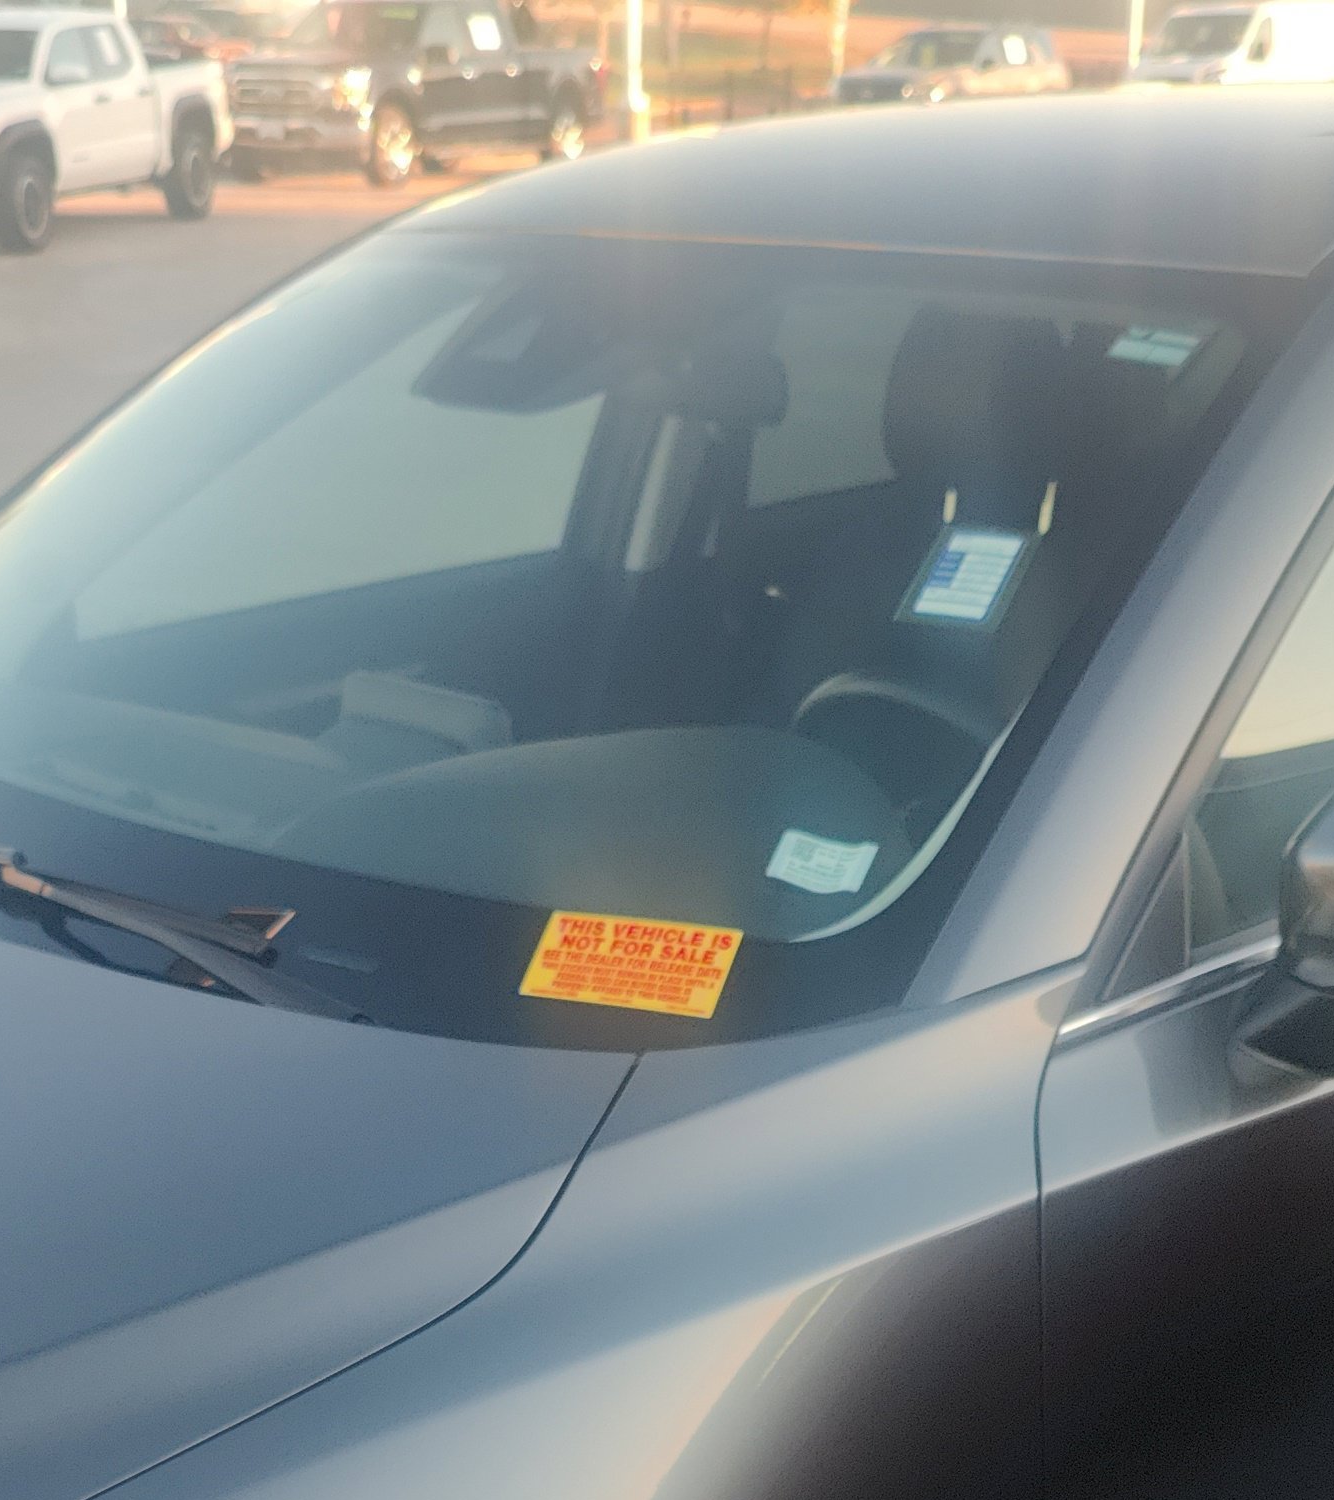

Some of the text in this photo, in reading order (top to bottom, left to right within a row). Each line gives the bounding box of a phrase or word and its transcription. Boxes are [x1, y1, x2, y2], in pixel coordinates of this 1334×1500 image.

[559, 918, 732, 950] THIS VEHICLE IS
[543, 949, 721, 979] SEE THE DEALER FOR RELEASE DATE
[560, 935, 717, 964] NOT FOR SALE
